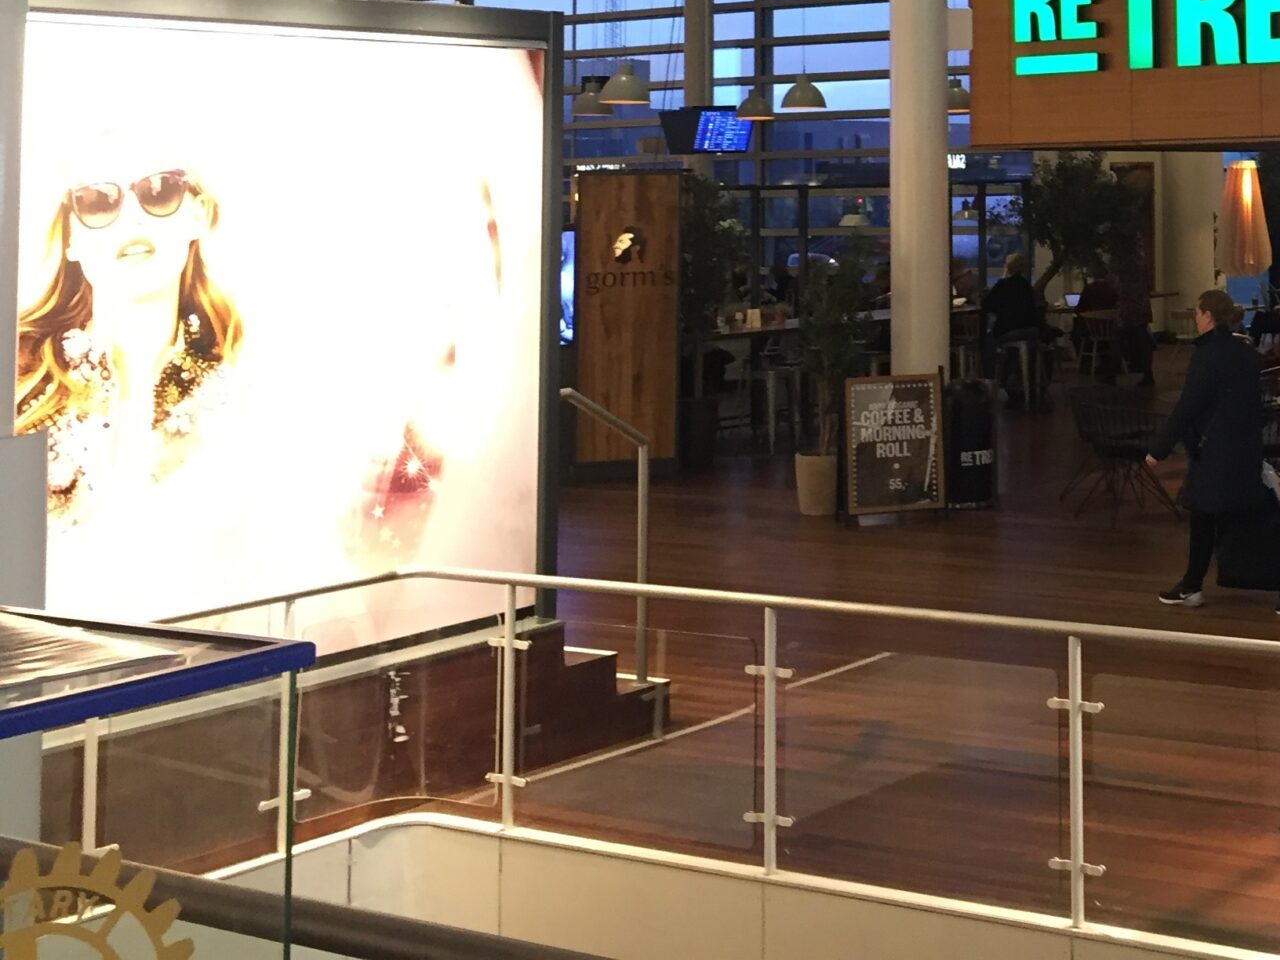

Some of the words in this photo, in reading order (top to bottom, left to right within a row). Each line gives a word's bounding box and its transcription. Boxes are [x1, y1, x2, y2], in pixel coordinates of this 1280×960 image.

[585, 265, 675, 296] gorm's
[860, 408, 911, 426] COFFEE
[913, 407, 925, 423] &
[860, 424, 926, 442] MORNING
[876, 442, 911, 458] ROLL
